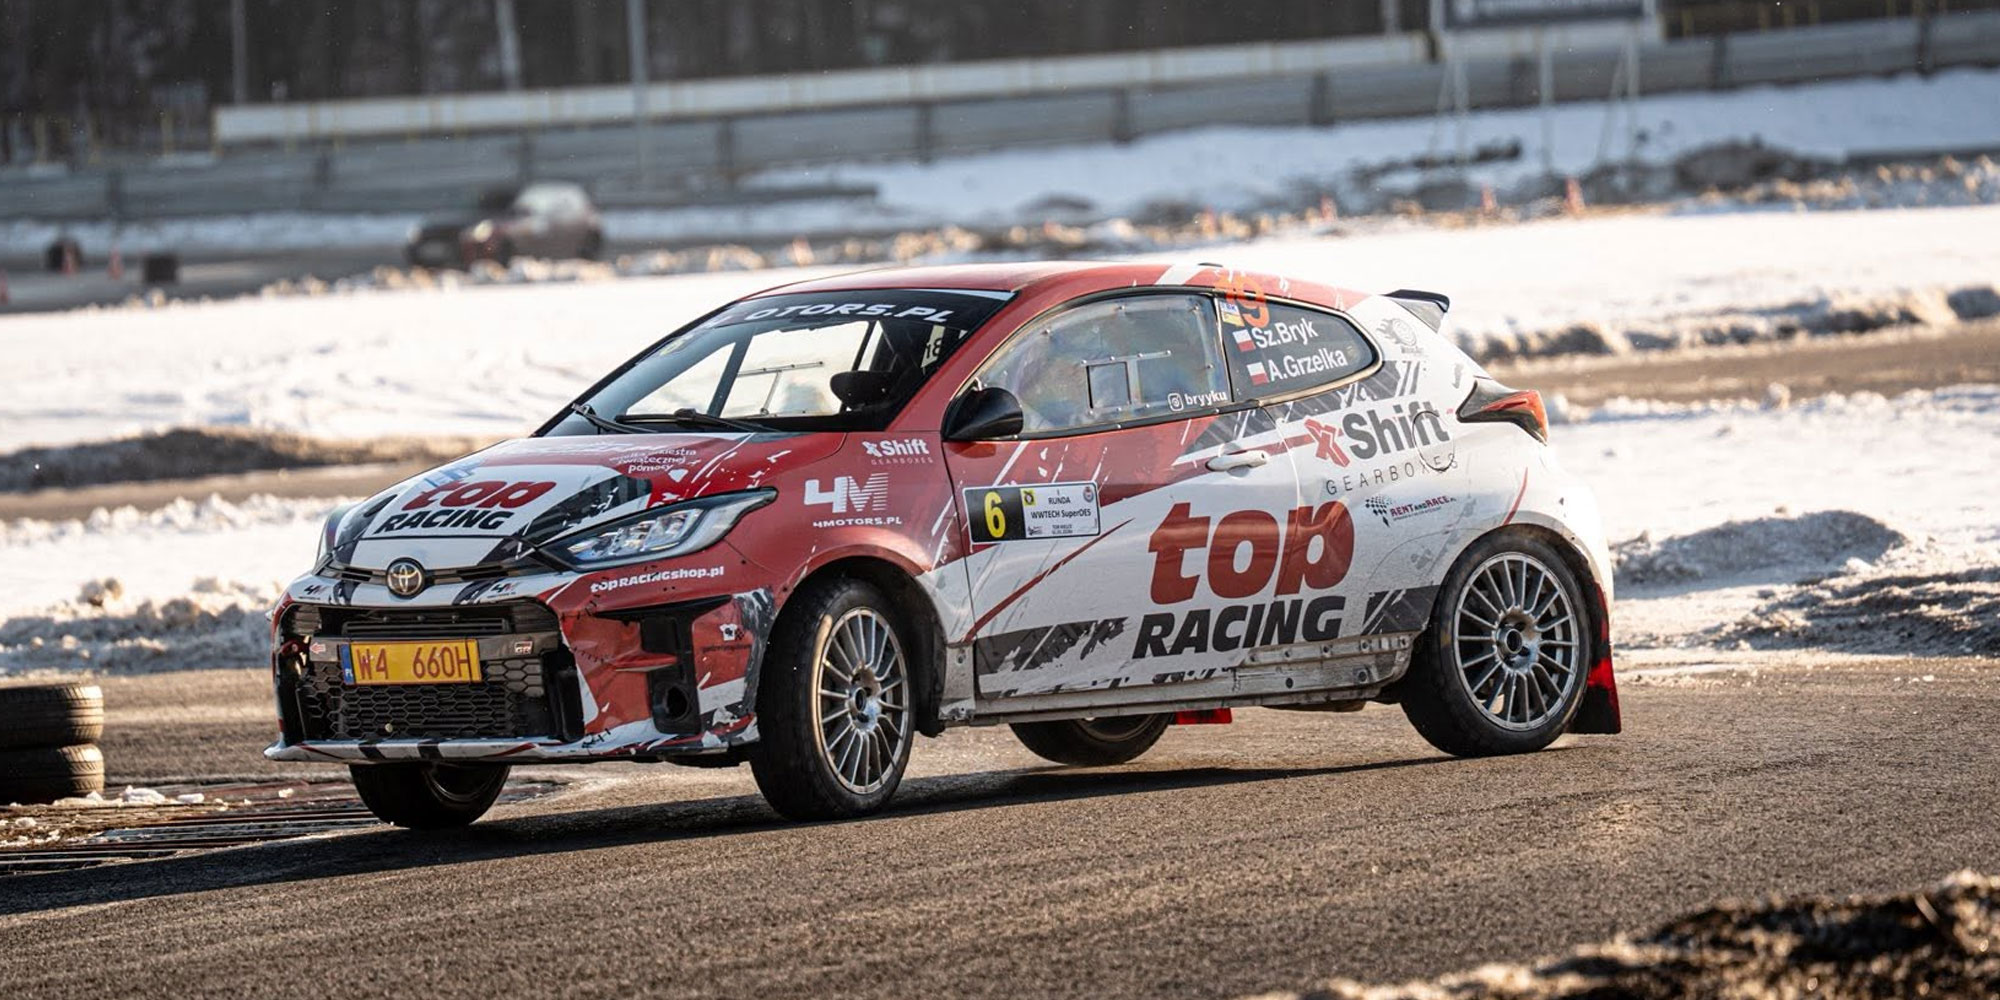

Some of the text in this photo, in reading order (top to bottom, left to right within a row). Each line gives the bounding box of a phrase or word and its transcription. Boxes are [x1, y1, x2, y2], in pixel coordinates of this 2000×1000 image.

[1251, 318, 1319, 348] Sz.Bryk
[1268, 347, 1349, 382] A.Grzelka
[1184, 390, 1228, 406] bryyku
[402, 480, 557, 512] top
[804, 472, 890, 513] 4M
[1048, 496, 1071, 505] RUNDA
[373, 509, 514, 536] RACING
[812, 516, 902, 528] 4MOTORS.PL
[984, 491, 1006, 538] 6
[1148, 500, 1355, 605] top
[1132, 595, 1347, 660] RACING
[355, 647, 389, 680] W4
